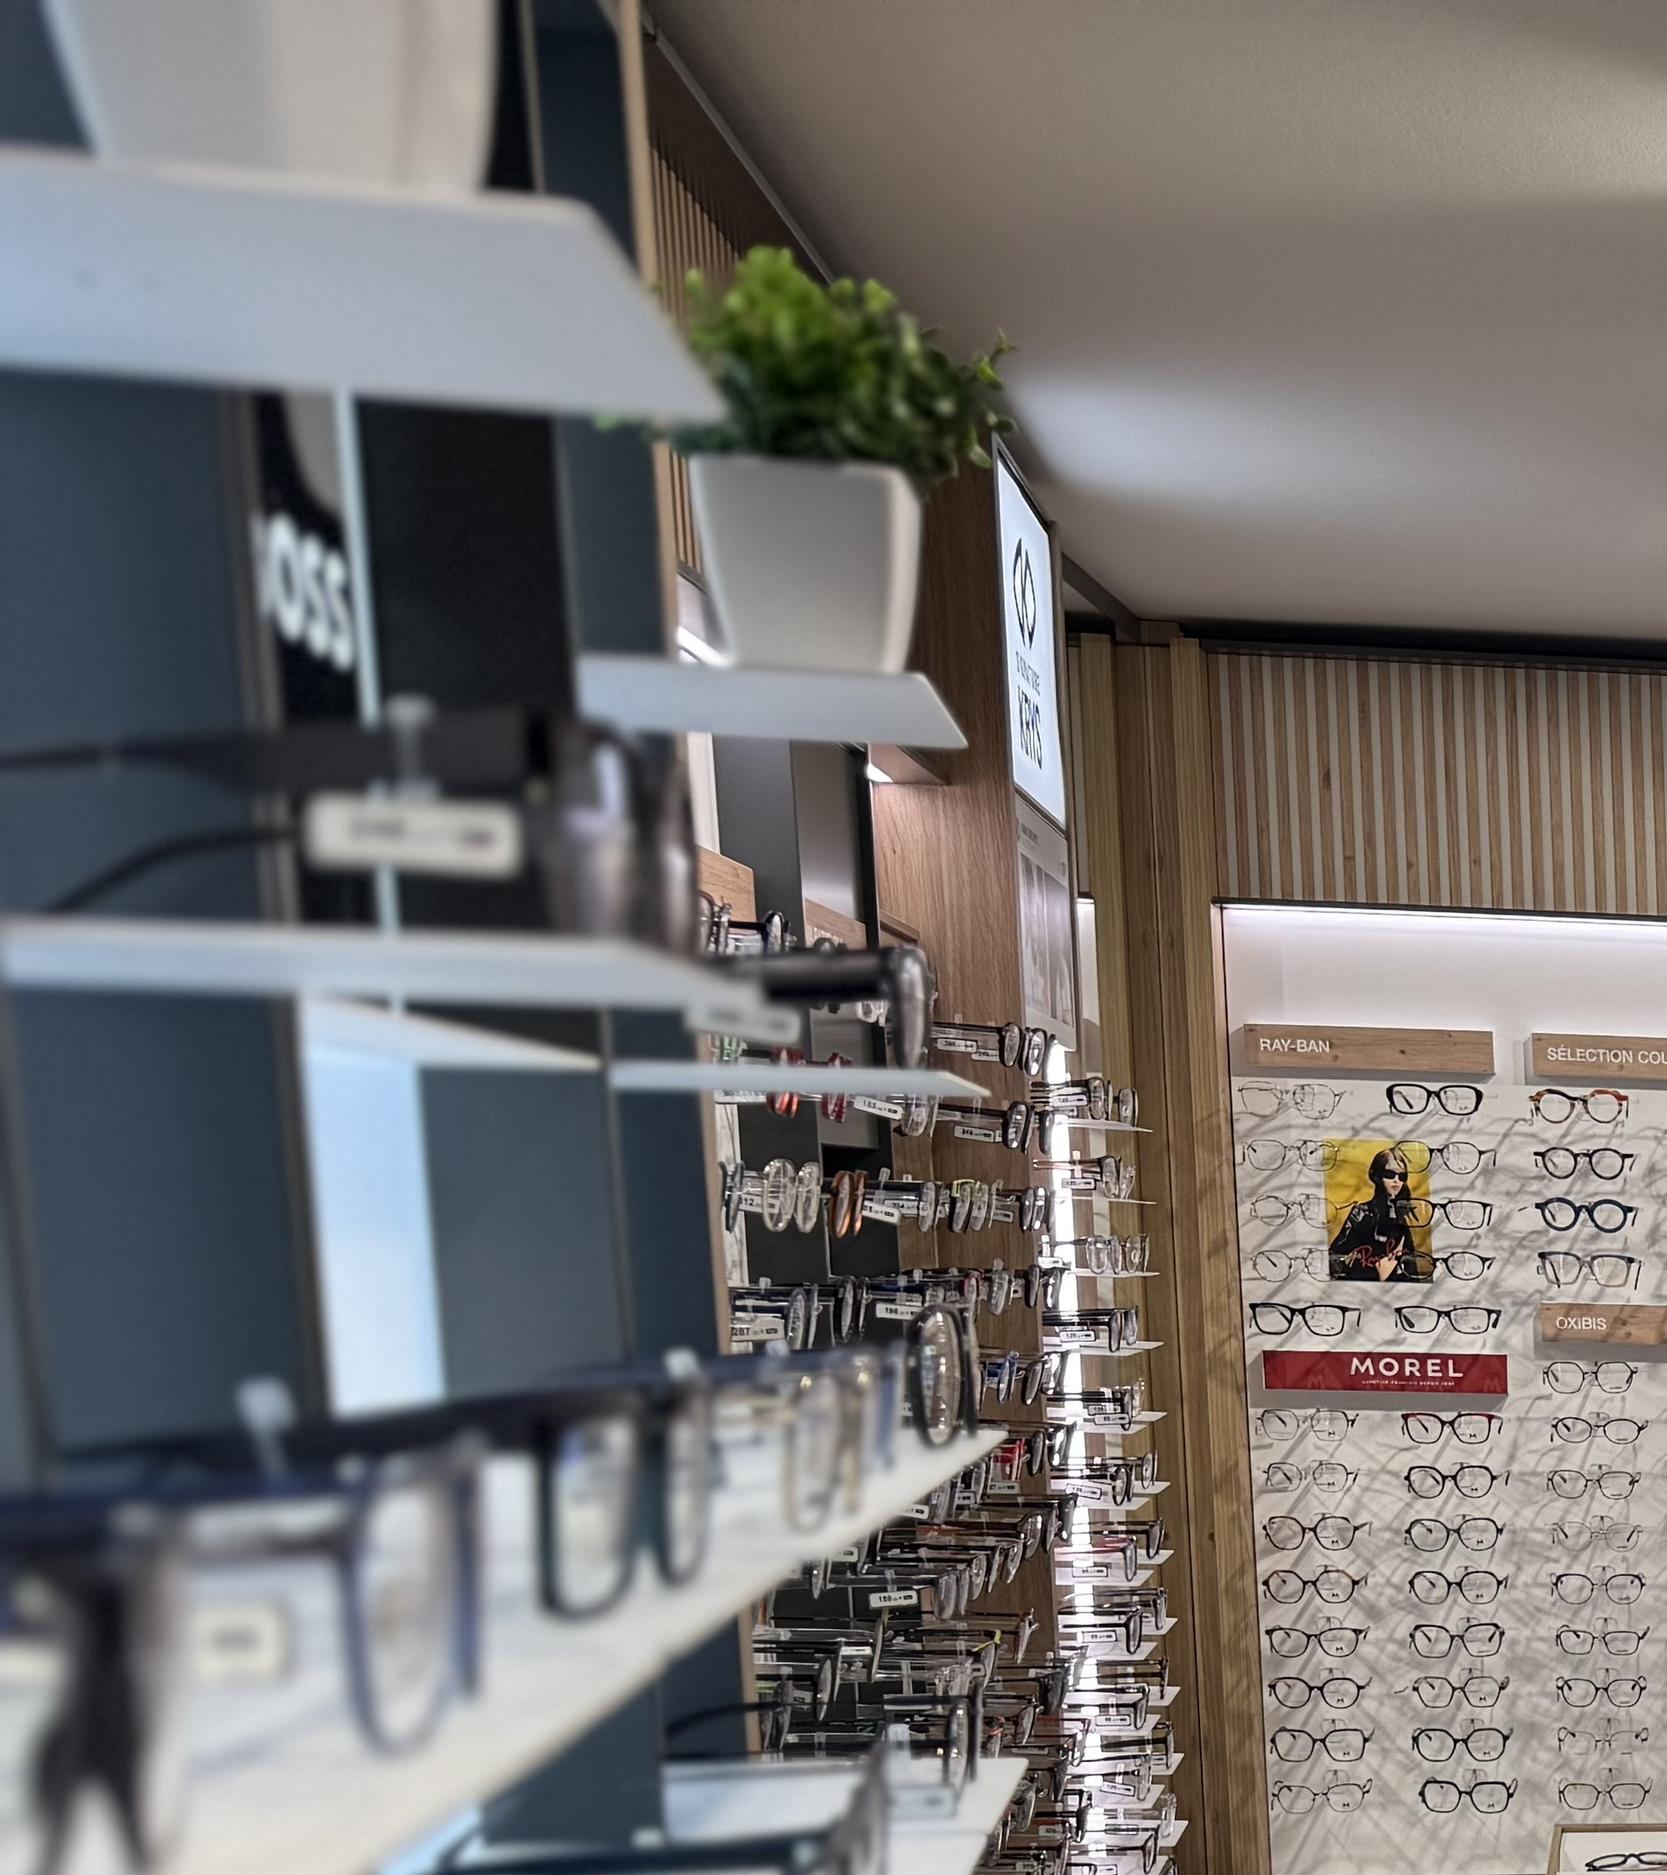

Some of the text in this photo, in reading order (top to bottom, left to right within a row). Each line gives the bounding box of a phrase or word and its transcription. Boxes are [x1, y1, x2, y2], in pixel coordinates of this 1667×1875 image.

[1259, 1038, 1331, 1053] RAY-BAN
[1546, 1044, 1634, 1064] SÉLECTION
[1555, 1316, 1607, 1330] OXIBIS
[1350, 1356, 1463, 1378] MOREL
